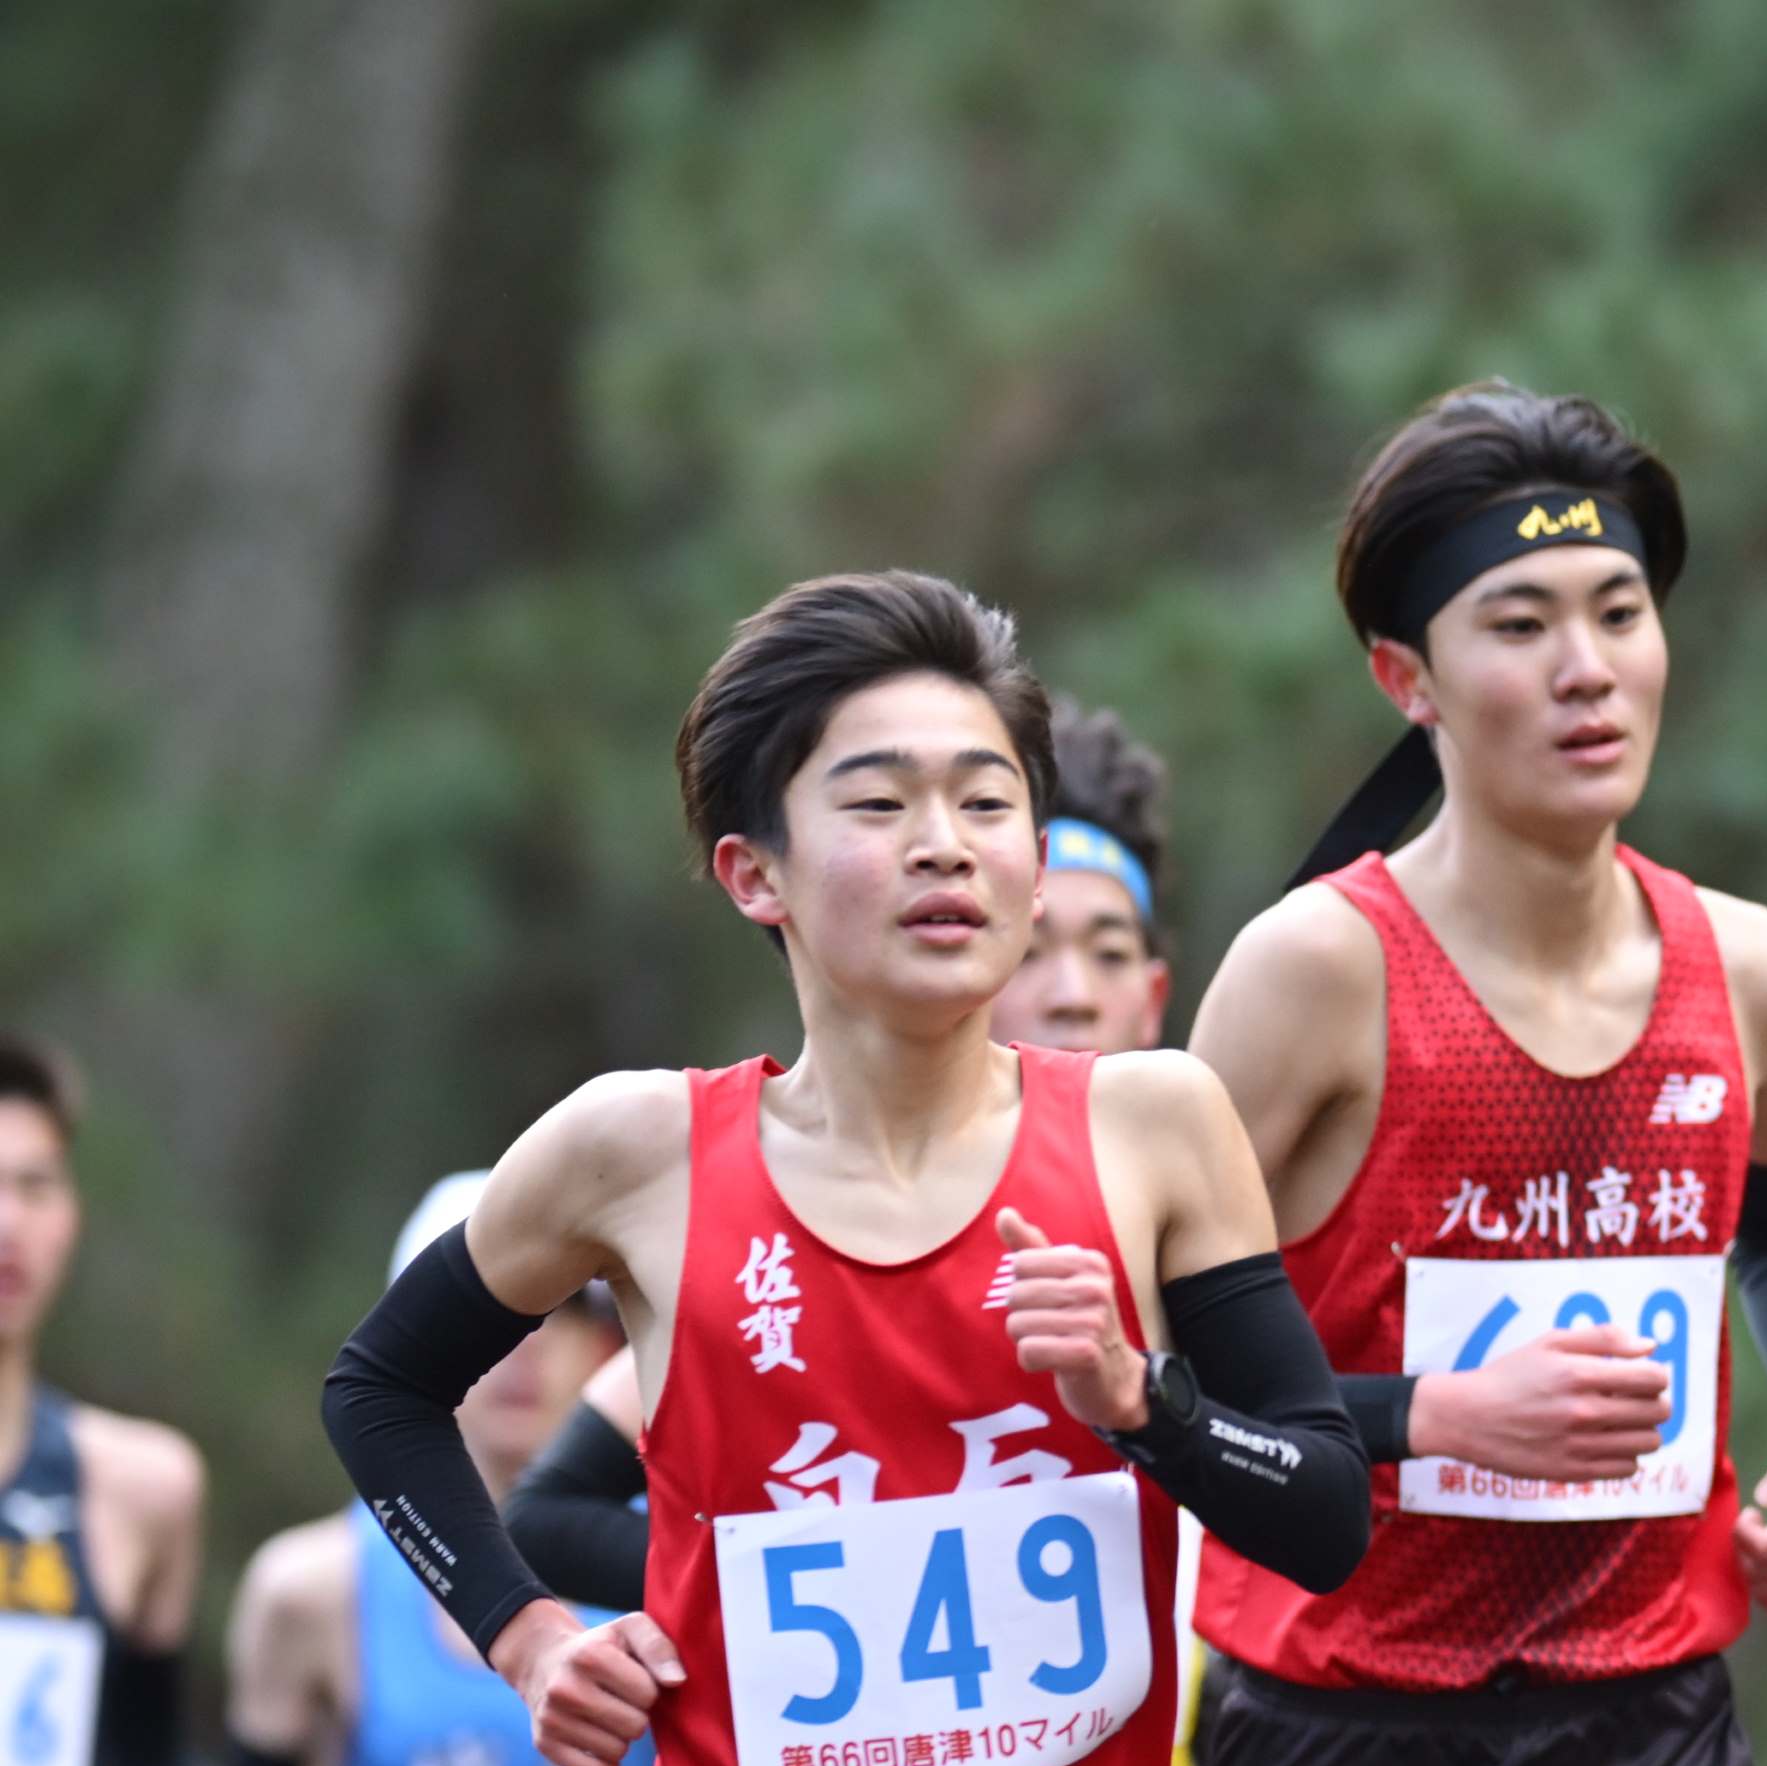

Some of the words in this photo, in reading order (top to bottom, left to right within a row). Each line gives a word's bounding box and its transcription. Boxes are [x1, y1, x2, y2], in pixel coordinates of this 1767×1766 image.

[1434, 1166, 1710, 1249] 九州高校
[735, 1233, 807, 1375] 佐賀
[762, 1513, 1108, 1726] 549
